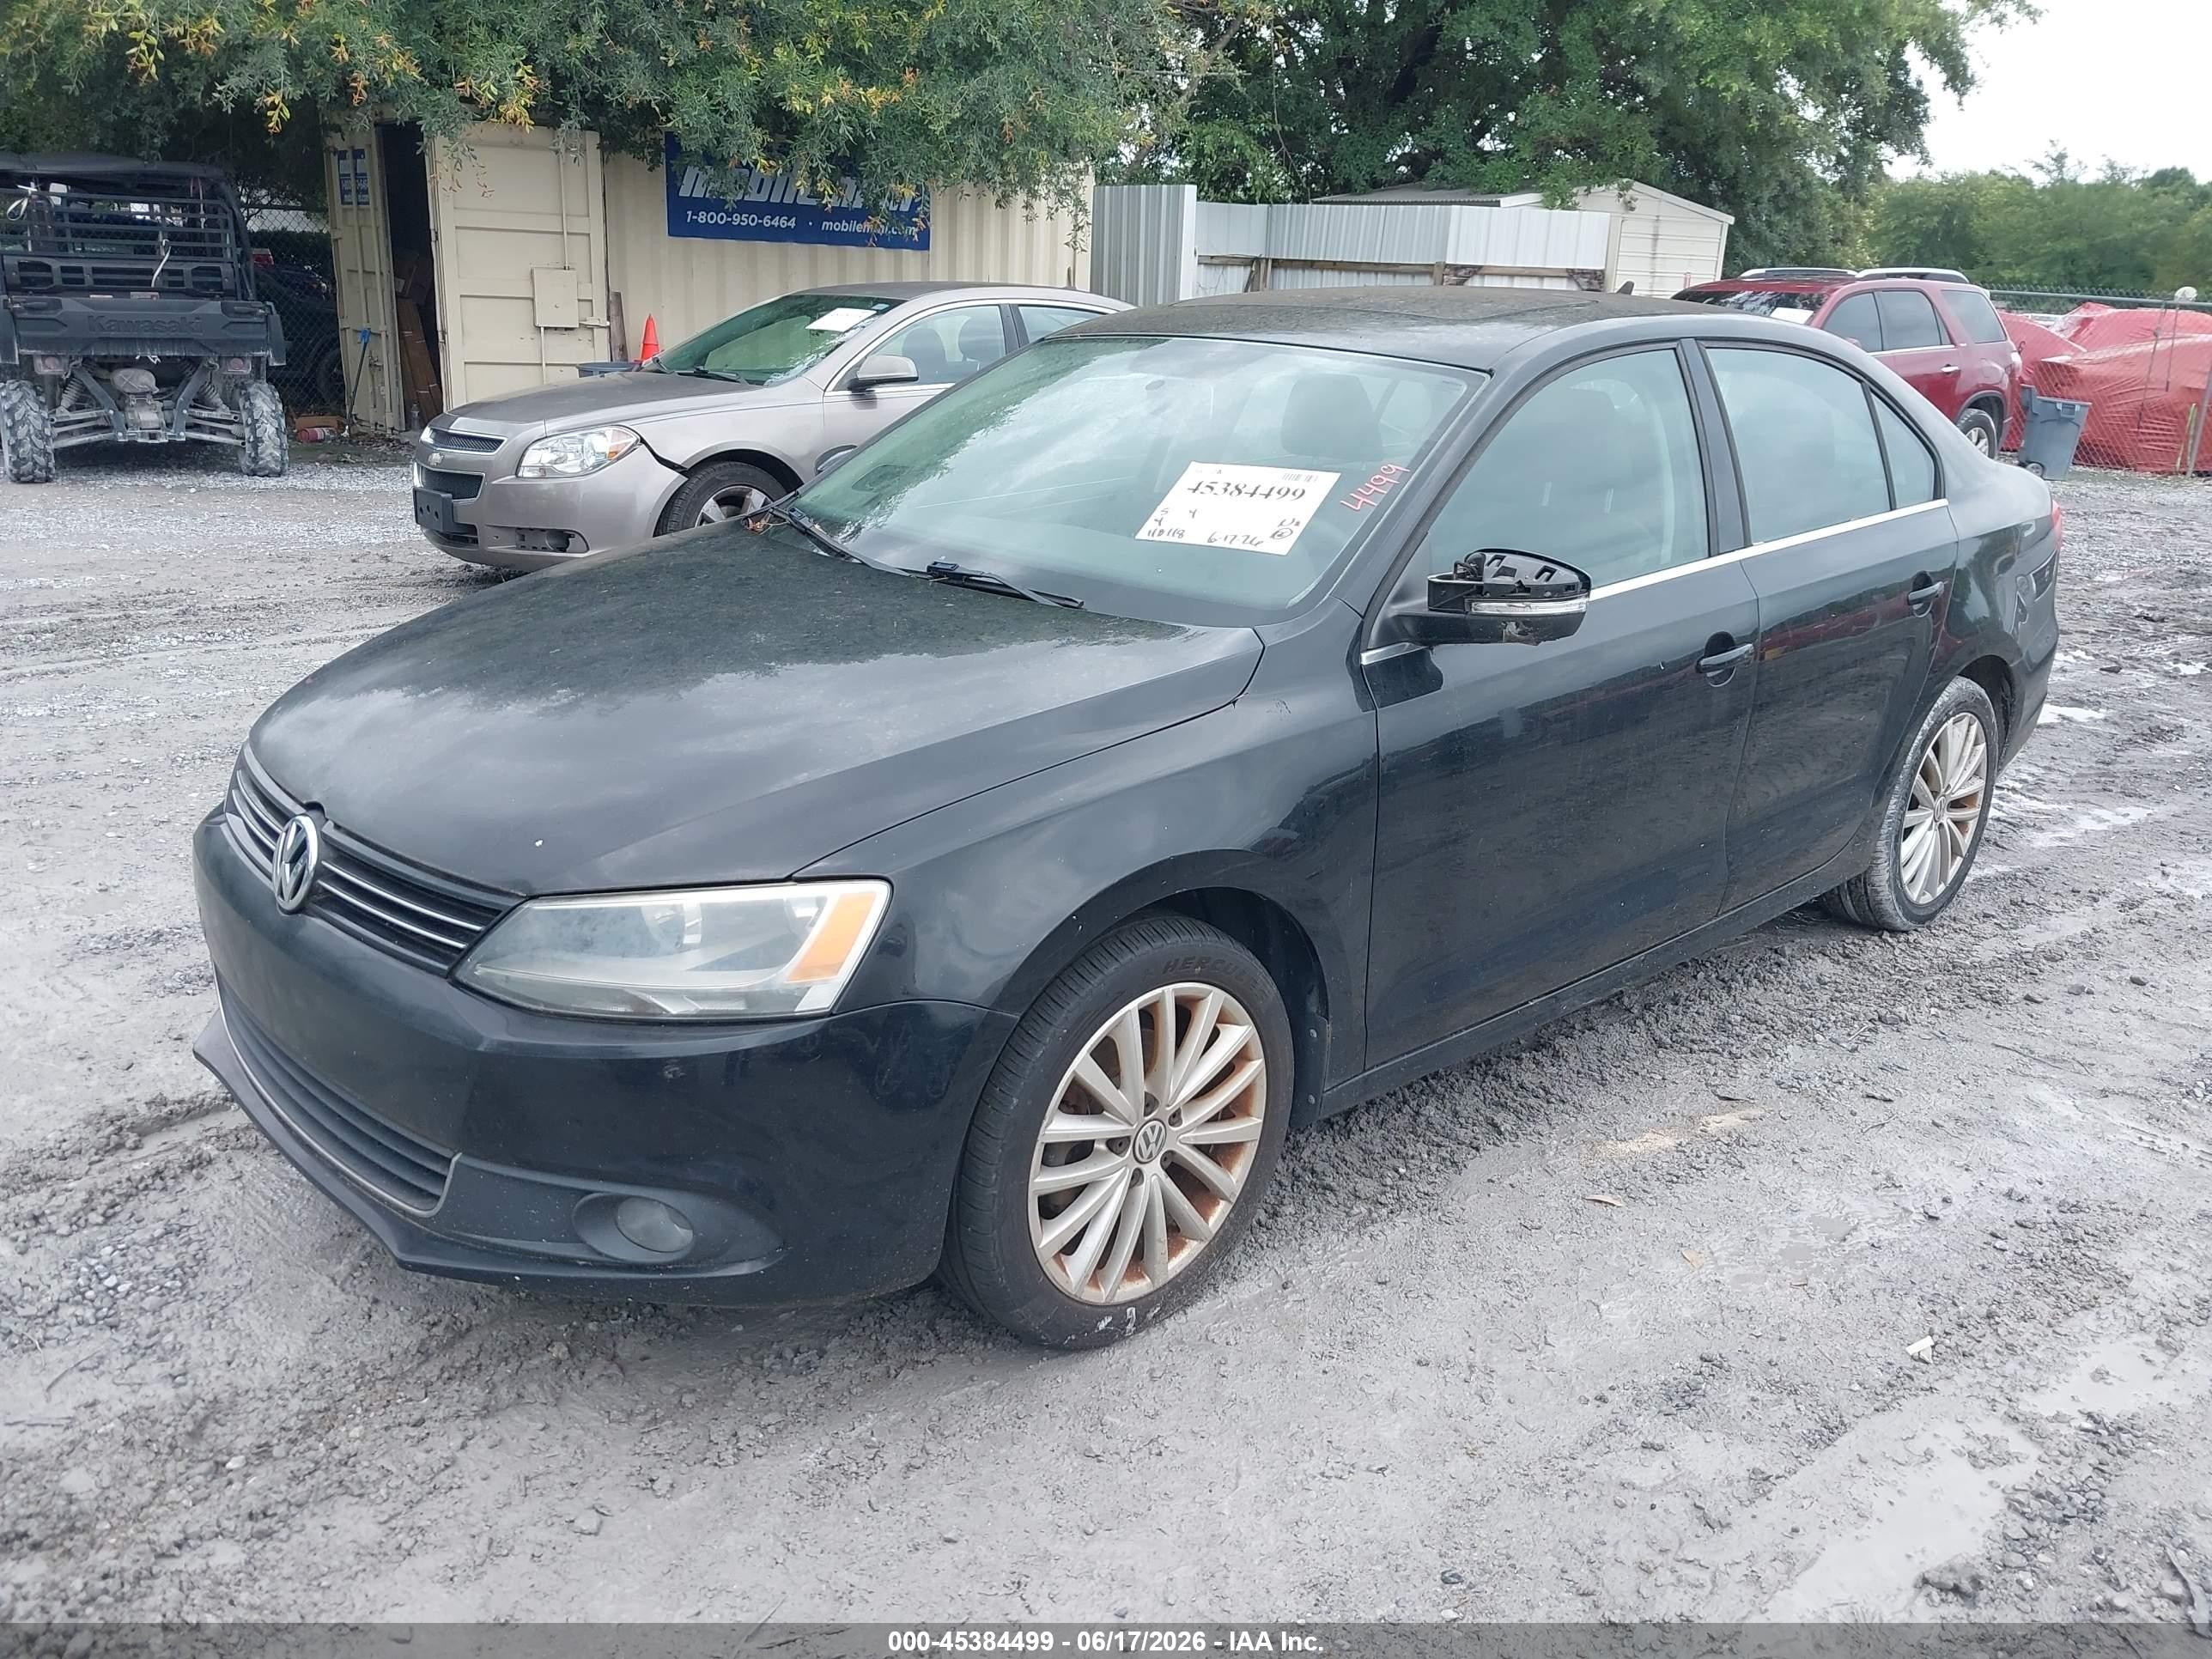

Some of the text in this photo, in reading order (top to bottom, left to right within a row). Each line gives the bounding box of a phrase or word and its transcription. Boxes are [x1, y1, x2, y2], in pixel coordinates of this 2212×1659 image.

[686, 210, 796, 229] 1-800-950-6464
[87, 314, 204, 336] Kawasaki
[1186, 481, 1306, 501] 45384499
[1340, 464, 1411, 512] 4499
